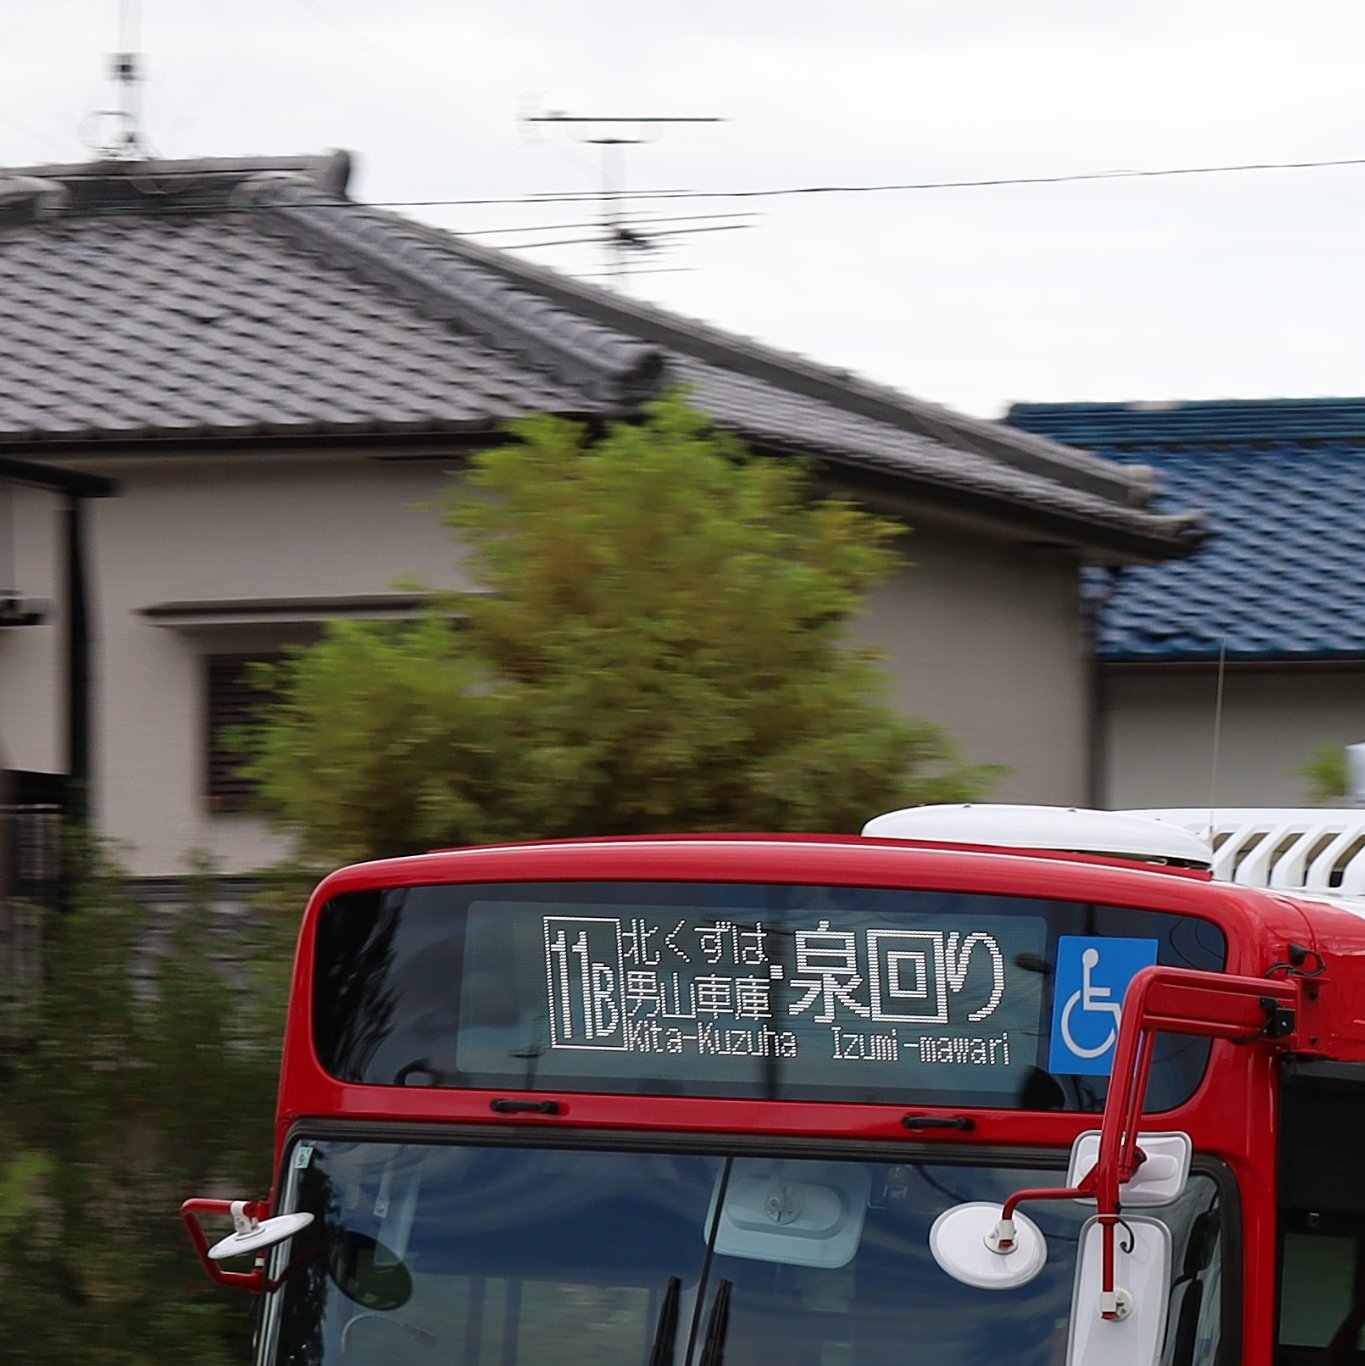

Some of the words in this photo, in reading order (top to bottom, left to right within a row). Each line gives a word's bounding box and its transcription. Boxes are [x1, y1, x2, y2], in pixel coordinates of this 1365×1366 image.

[621, 918, 768, 965] 北くずは
[626, 971, 772, 1021] 男山車庫
[627, 1019, 797, 1058] Kita-Kuzuha
[831, 1025, 1010, 1065] Izumi-mawari
